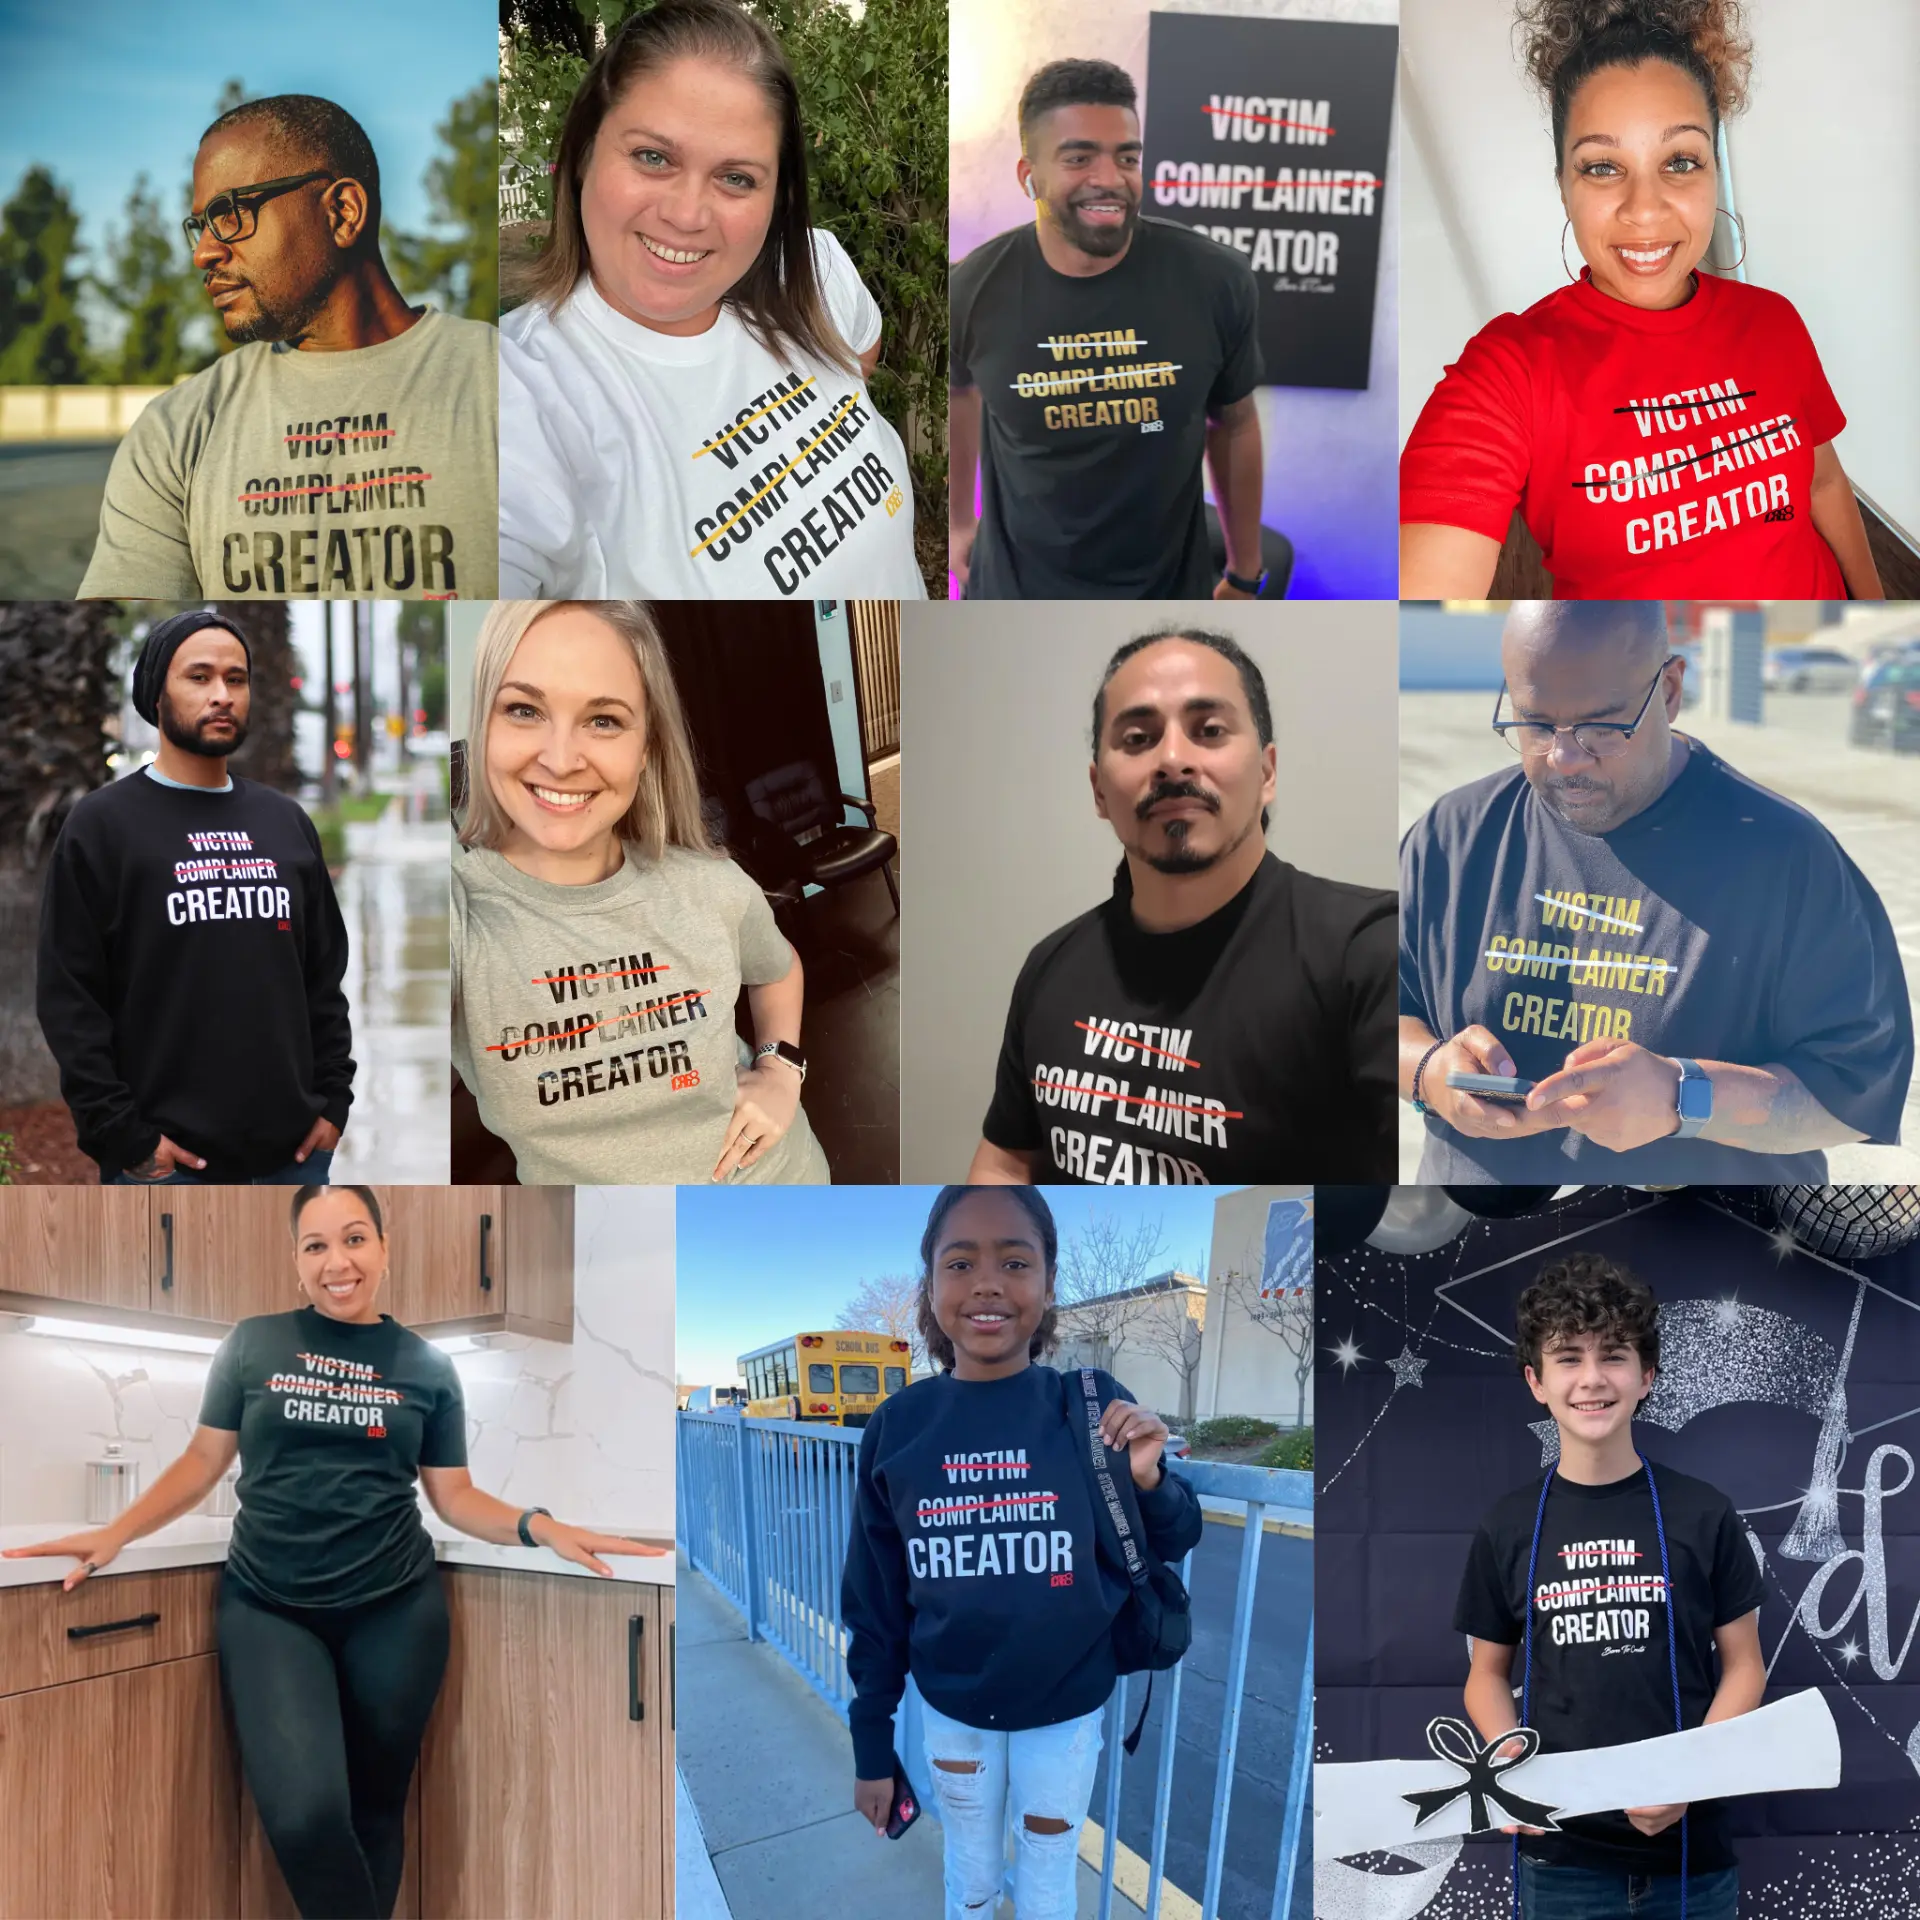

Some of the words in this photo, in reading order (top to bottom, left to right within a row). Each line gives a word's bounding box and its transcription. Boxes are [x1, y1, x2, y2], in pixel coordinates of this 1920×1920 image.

[1210, 94, 1330, 146] VICTIM
[1154, 160, 1376, 216] COMPLAINER
[1191, 224, 1340, 276] EATOR
[1048, 328, 1138, 362] VICTIM
[1016, 361, 1177, 398] COMPLAINER
[702, 371, 818, 470] VICTIM
[1044, 397, 1160, 430] CREATOR
[1629, 378, 1747, 438] VICTIM
[286, 412, 389, 460] VICTIM
[1584, 413, 1801, 504] COMPLAINER
[244, 466, 426, 517] COMPLAINER
[694, 394, 871, 562] COMPLAINER
[763, 452, 894, 596] CREATOR
[1626, 473, 1790, 555] CREATOR
[222, 524, 457, 593] CREATOR
[187, 831, 253, 852] VICTIM
[175, 858, 278, 884] COMPLAINER
[167, 885, 290, 926] CREATOR
[1541, 889, 1642, 937] VICTIM
[544, 951, 657, 1005] VICTIM
[1486, 935, 1668, 997] COMPLAINER
[500, 988, 708, 1062] COMPLAINER
[1502, 991, 1632, 1043] CREATOR
[1083, 1015, 1193, 1073] VICTIM
[537, 1039, 694, 1107] CREATOR
[1034, 1063, 1228, 1149] COMPLAINER
[304, 1352, 374, 1382] VICTIM
[836, 1340, 863, 1353] SCHOOL
[866, 1341, 880, 1354] BUS
[270, 1373, 400, 1406] COMPLAINER
[283, 1398, 384, 1428] CREATOR
[944, 1449, 1028, 1484] VICTIM
[918, 1491, 1056, 1528] COMPLAINER
[907, 1530, 1073, 1579] CREATOR
[1563, 1539, 1636, 1571] VICTIM
[1536, 1575, 1667, 1612] COMPLAINER
[1551, 1609, 1650, 1646] CREATOR
